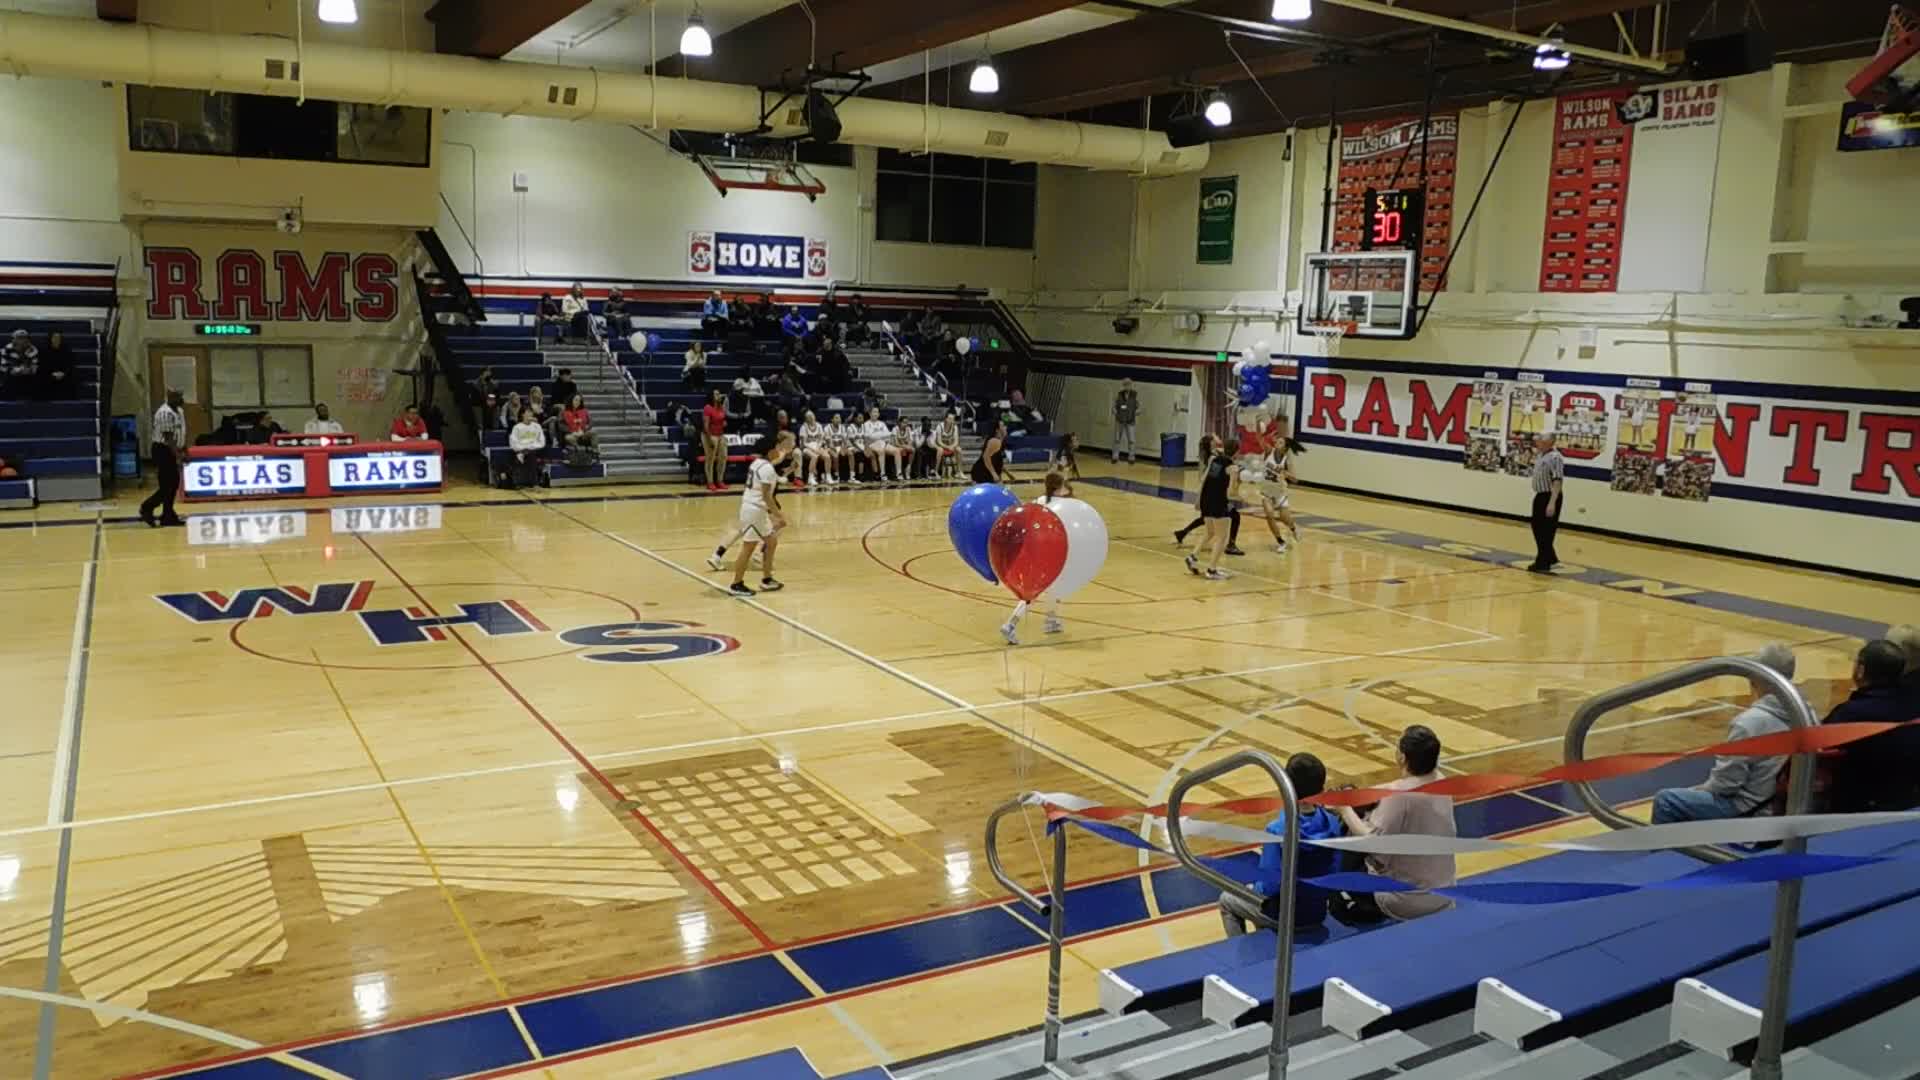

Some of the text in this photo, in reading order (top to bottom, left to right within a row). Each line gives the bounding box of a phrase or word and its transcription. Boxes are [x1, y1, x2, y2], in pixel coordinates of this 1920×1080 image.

[1563, 98, 1611, 114] WILSON
[1663, 84, 1719, 104] SILAS
[1563, 114, 1609, 130] RAMS
[1663, 102, 1716, 121] RAMS
[1343, 129, 1402, 155] WILSON
[1373, 211, 1401, 243] 30
[718, 242, 801, 269] HOME
[144, 246, 398, 322] RAMS
[1308, 373, 1474, 445] RAM
[197, 463, 293, 487] SILAS
[343, 459, 428, 482] RAMS
